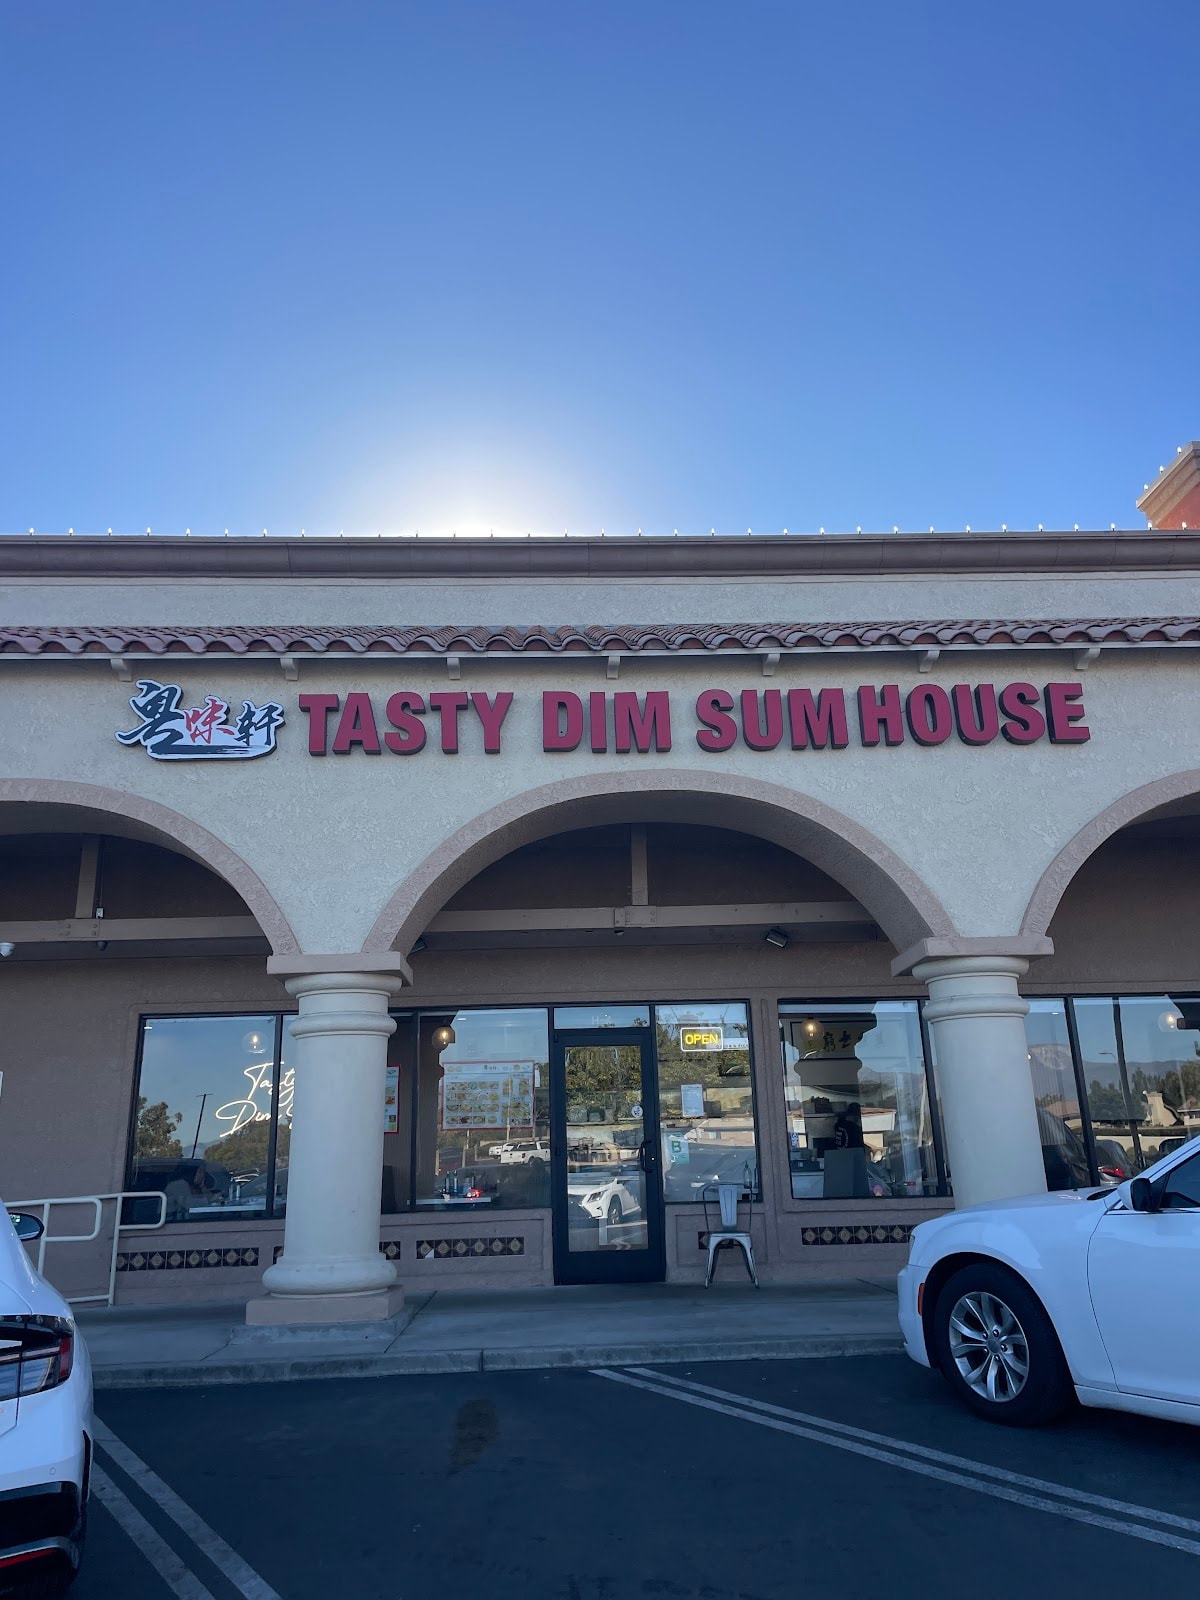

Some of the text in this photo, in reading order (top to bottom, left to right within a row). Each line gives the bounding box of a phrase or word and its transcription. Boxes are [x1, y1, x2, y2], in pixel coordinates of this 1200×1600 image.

[299, 682, 1091, 756] TASTY DIM SUM HOUSE
[685, 1033, 719, 1045] OPEN
[243, 1061, 296, 1107] Taty
[671, 1140, 682, 1153] B
